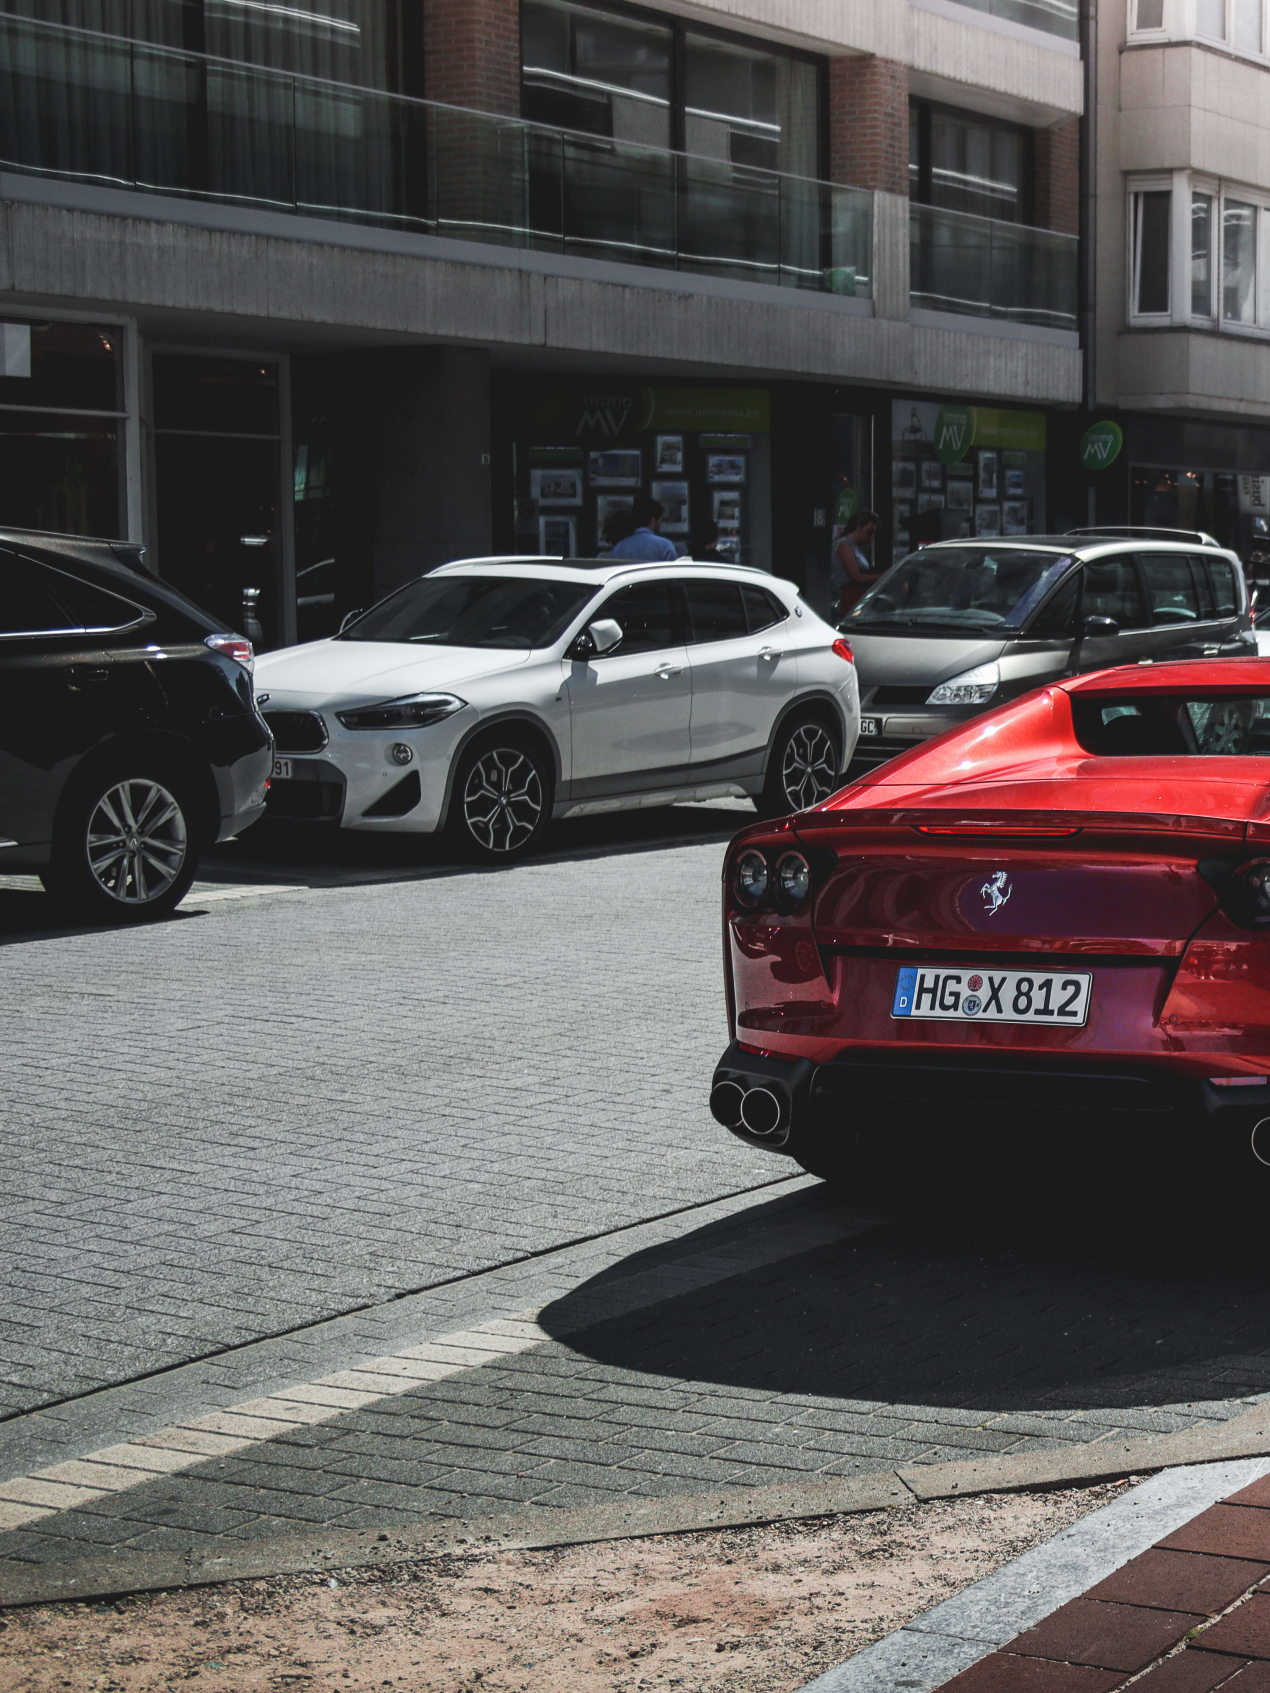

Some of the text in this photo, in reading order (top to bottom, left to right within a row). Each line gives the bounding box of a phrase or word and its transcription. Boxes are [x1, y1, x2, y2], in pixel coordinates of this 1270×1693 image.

[583, 394, 633, 408] immo
[574, 408, 630, 436] MV
[942, 410, 967, 424] immo
[938, 424, 967, 450] MV
[1088, 432, 1114, 442] immo
[1082, 442, 1112, 460] MV
[900, 996, 908, 1008] D
[915, 974, 1081, 1017] HG X 812
